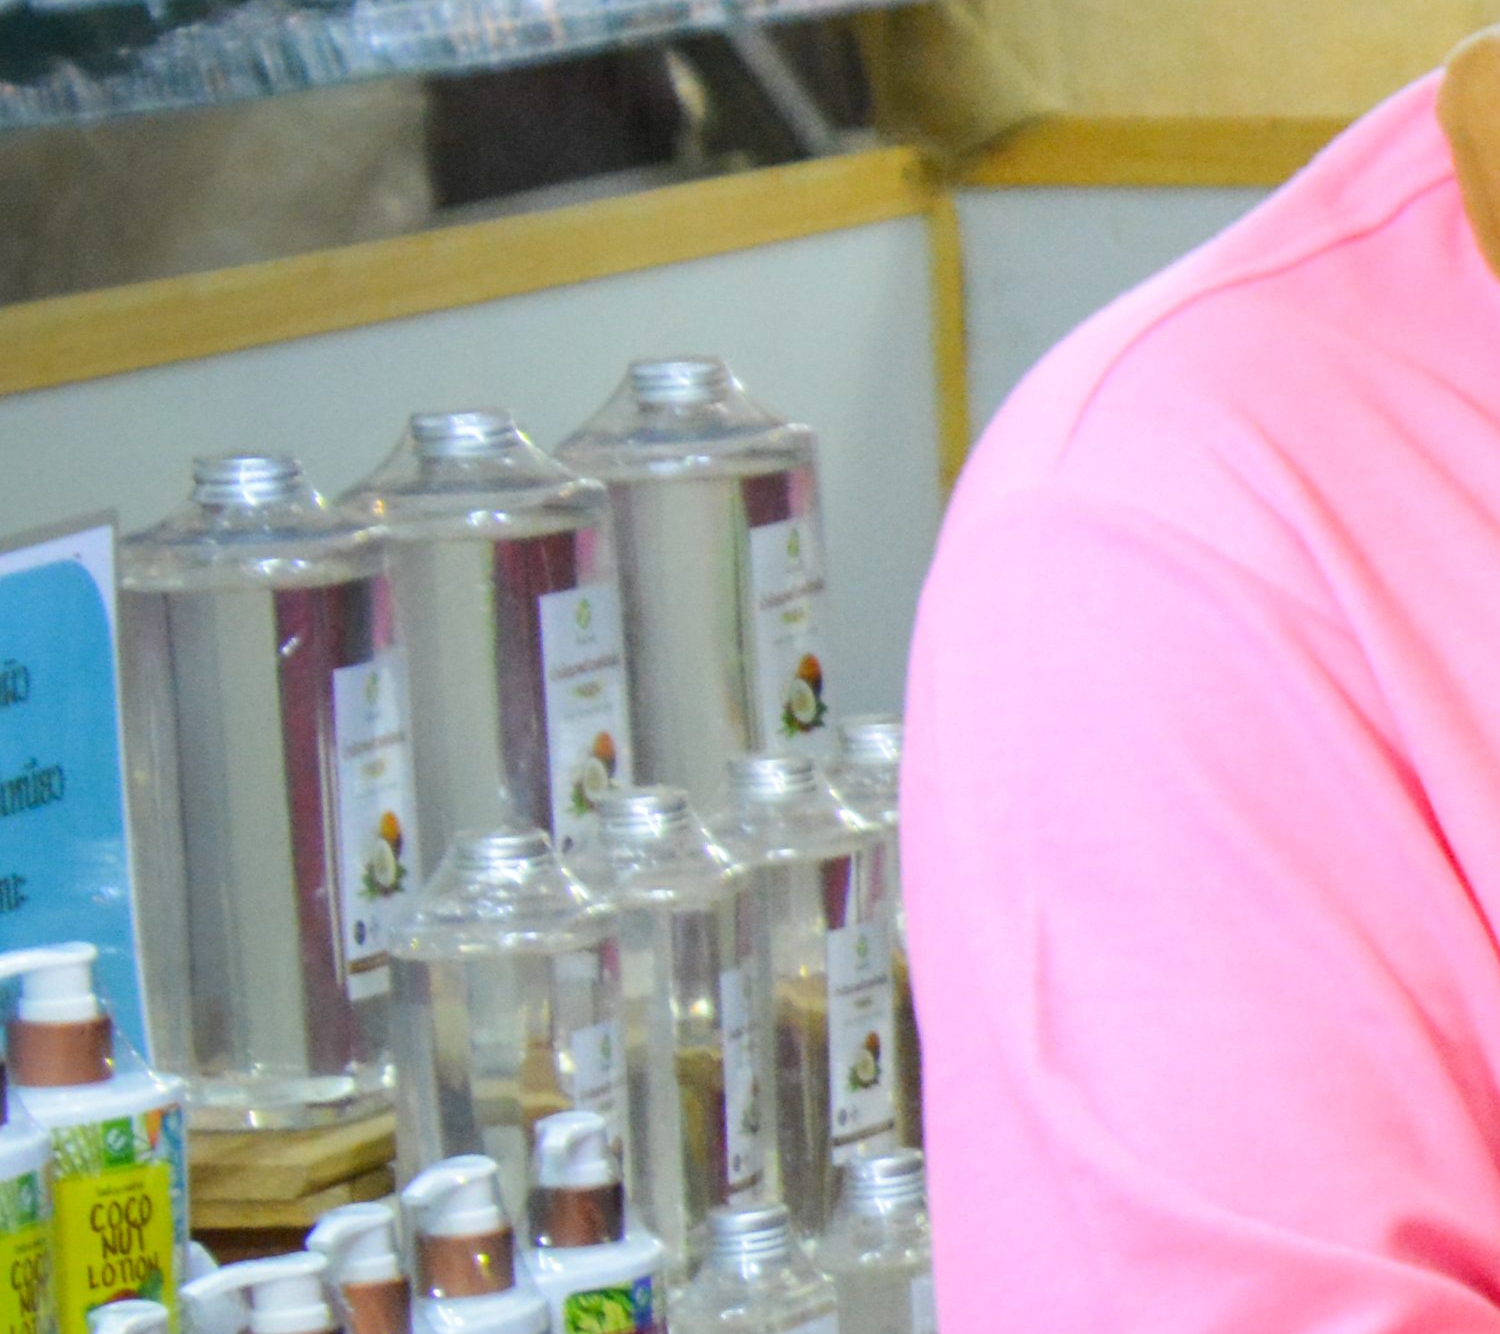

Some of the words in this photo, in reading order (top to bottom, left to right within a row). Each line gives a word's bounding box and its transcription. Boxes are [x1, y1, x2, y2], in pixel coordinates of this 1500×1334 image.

[89, 1192, 154, 1233] COCO
[100, 1227, 146, 1260] NUT
[87, 1250, 160, 1290] LOTION
